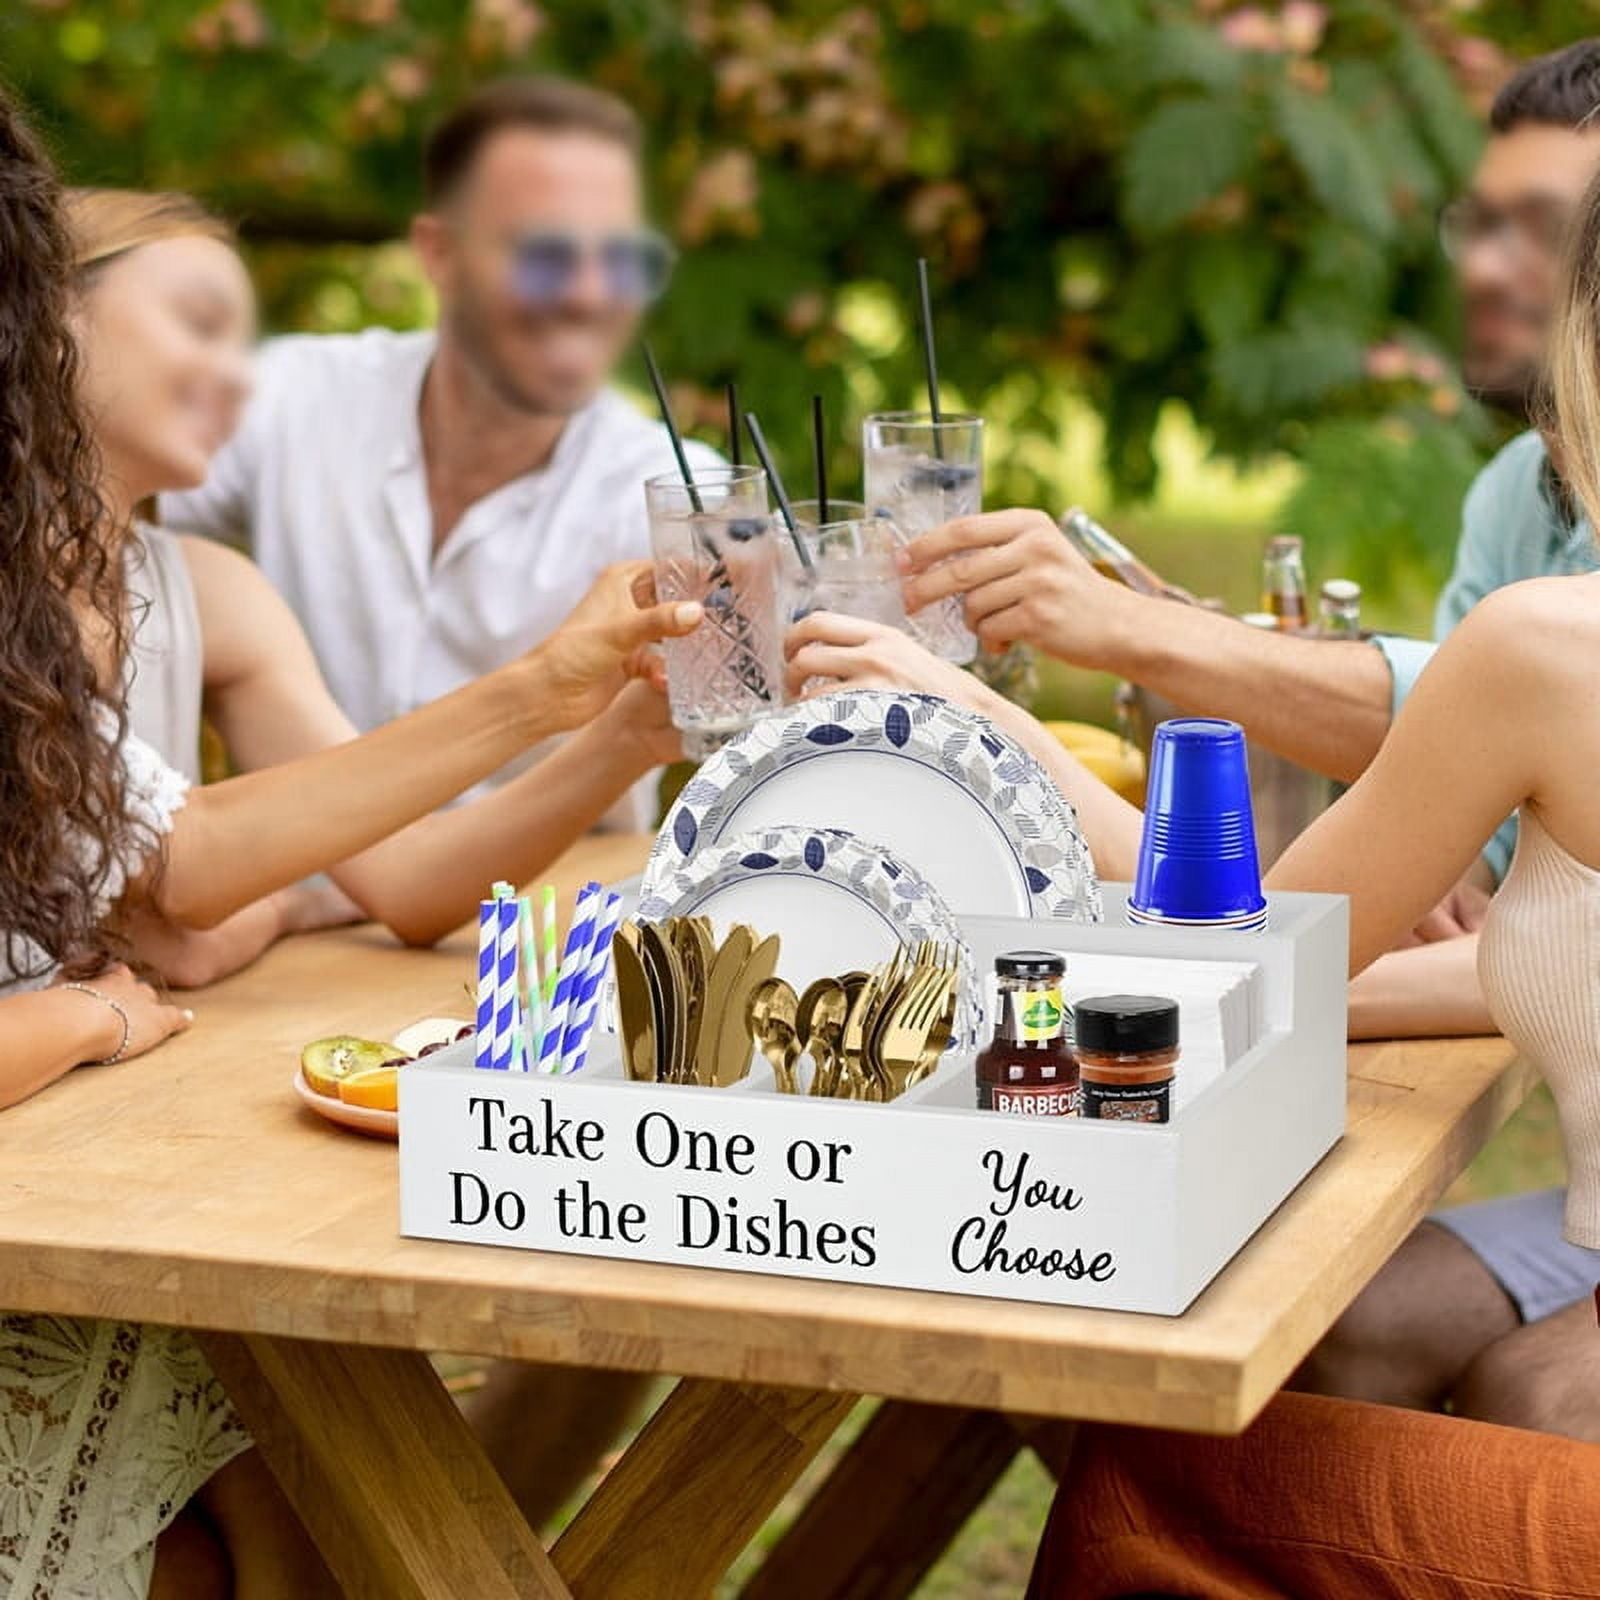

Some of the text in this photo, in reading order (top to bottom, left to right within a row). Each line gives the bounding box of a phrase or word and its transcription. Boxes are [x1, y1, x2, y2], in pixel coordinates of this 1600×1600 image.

[998, 1092, 1076, 1115] BARBECU
[469, 1097, 852, 1184] Take One or
[982, 1149, 1083, 1217] You
[448, 1171, 876, 1267] Do the Dishes
[951, 1216, 1117, 1283] Choose
